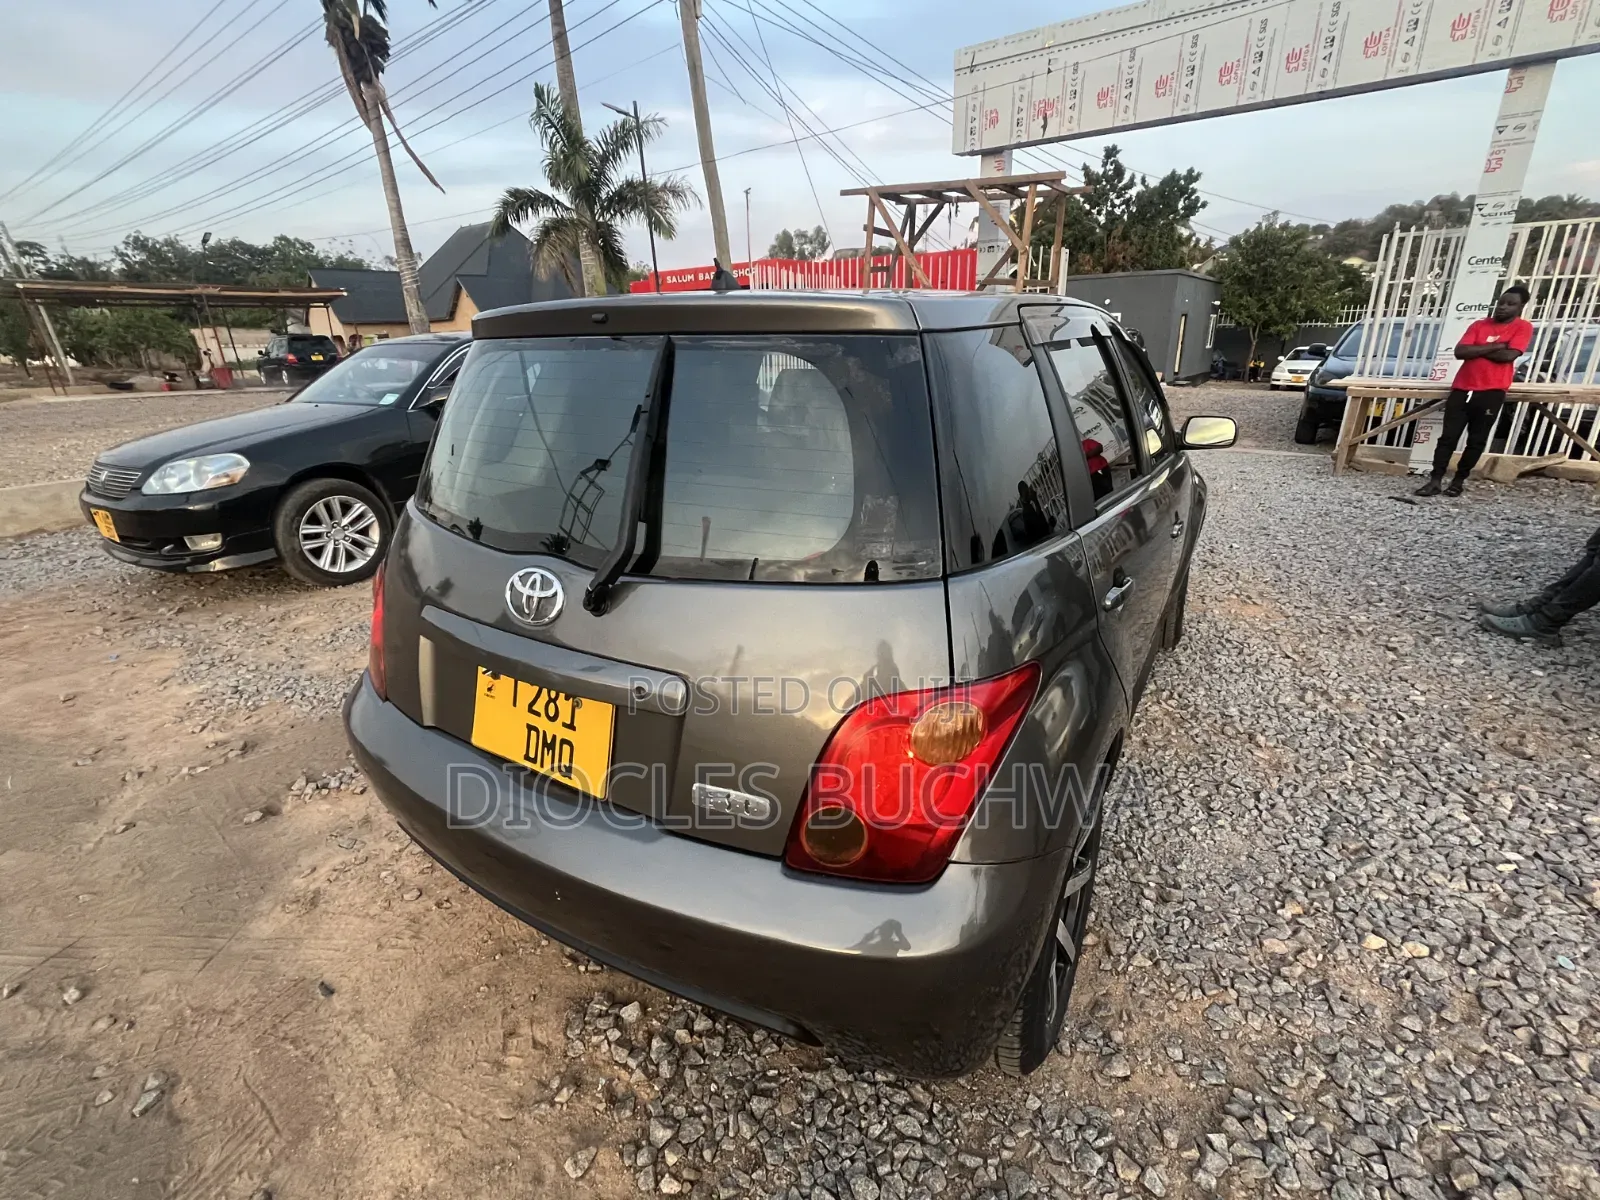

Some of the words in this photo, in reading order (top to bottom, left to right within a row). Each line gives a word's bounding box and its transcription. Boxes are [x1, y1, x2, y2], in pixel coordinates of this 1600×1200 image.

[1469, 8, 1482, 39] LOFIDA
[1381, 26, 1391, 56] LOFIDA
[1301, 44, 1310, 71] LOFIDA
[666, 273, 694, 284] SALUM
[527, 684, 577, 732] 281
[523, 722, 575, 780] DMQ
